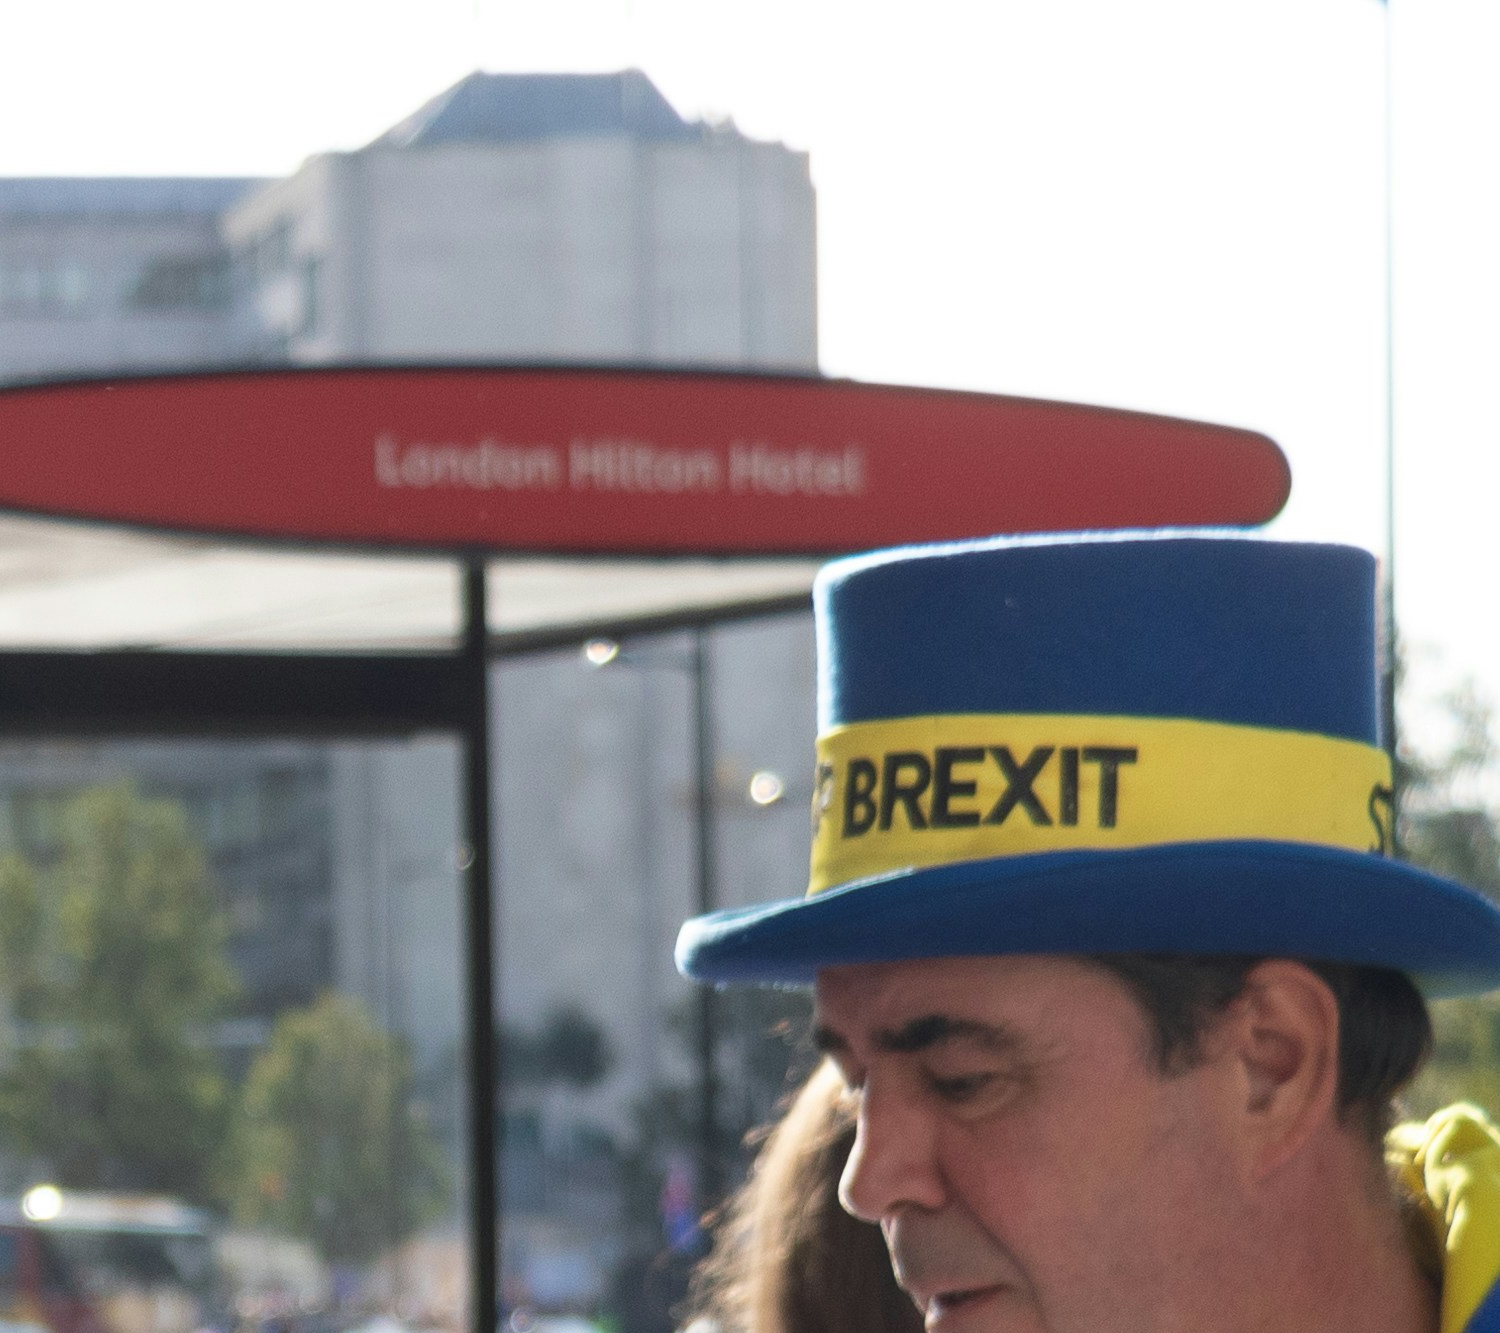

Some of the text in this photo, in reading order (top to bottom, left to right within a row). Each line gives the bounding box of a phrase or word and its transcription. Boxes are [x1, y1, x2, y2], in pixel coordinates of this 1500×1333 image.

[374, 432, 865, 498] London Hilton Hotel
[841, 745, 1138, 839] BREXIT
